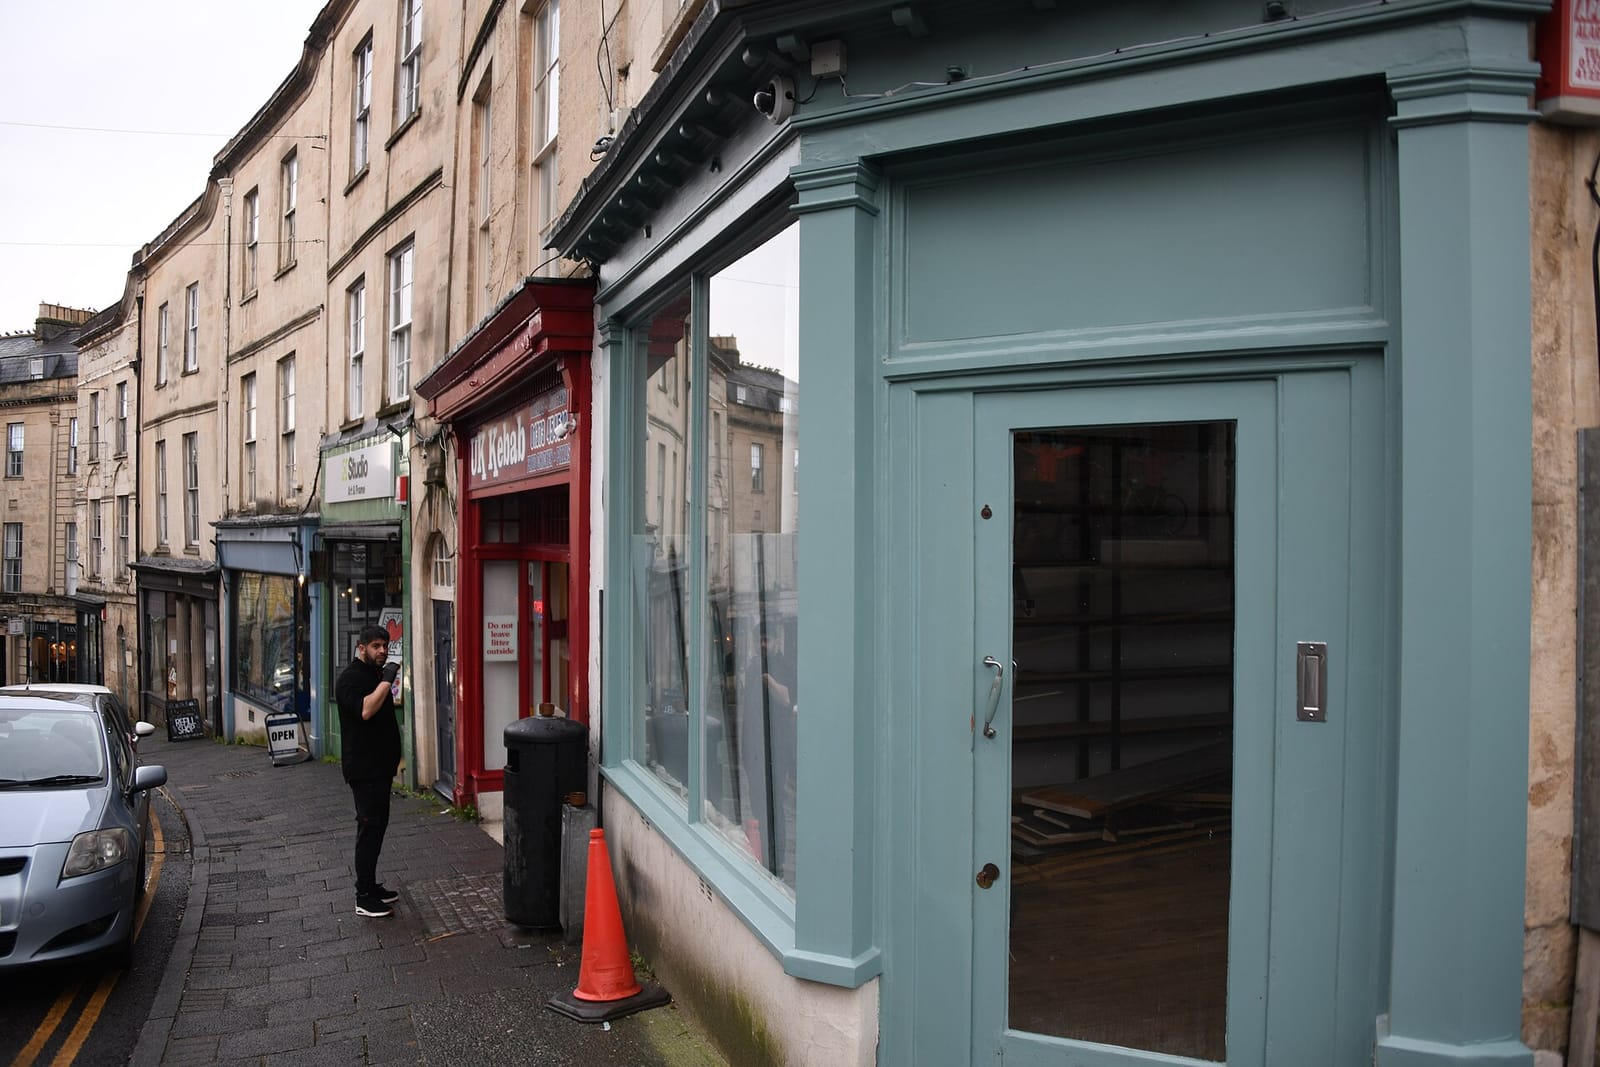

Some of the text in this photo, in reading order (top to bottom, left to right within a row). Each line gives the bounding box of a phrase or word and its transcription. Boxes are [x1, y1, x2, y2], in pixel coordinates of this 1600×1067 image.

[470, 432, 487, 481] UK
[488, 415, 526, 478] Kebab
[348, 454, 368, 481] Studio
[491, 630, 511, 638] leave
[486, 647, 514, 655] outside
[174, 716, 197, 727] REFILL
[178, 724, 196, 735] SHOP
[271, 729, 295, 742] OPEN
